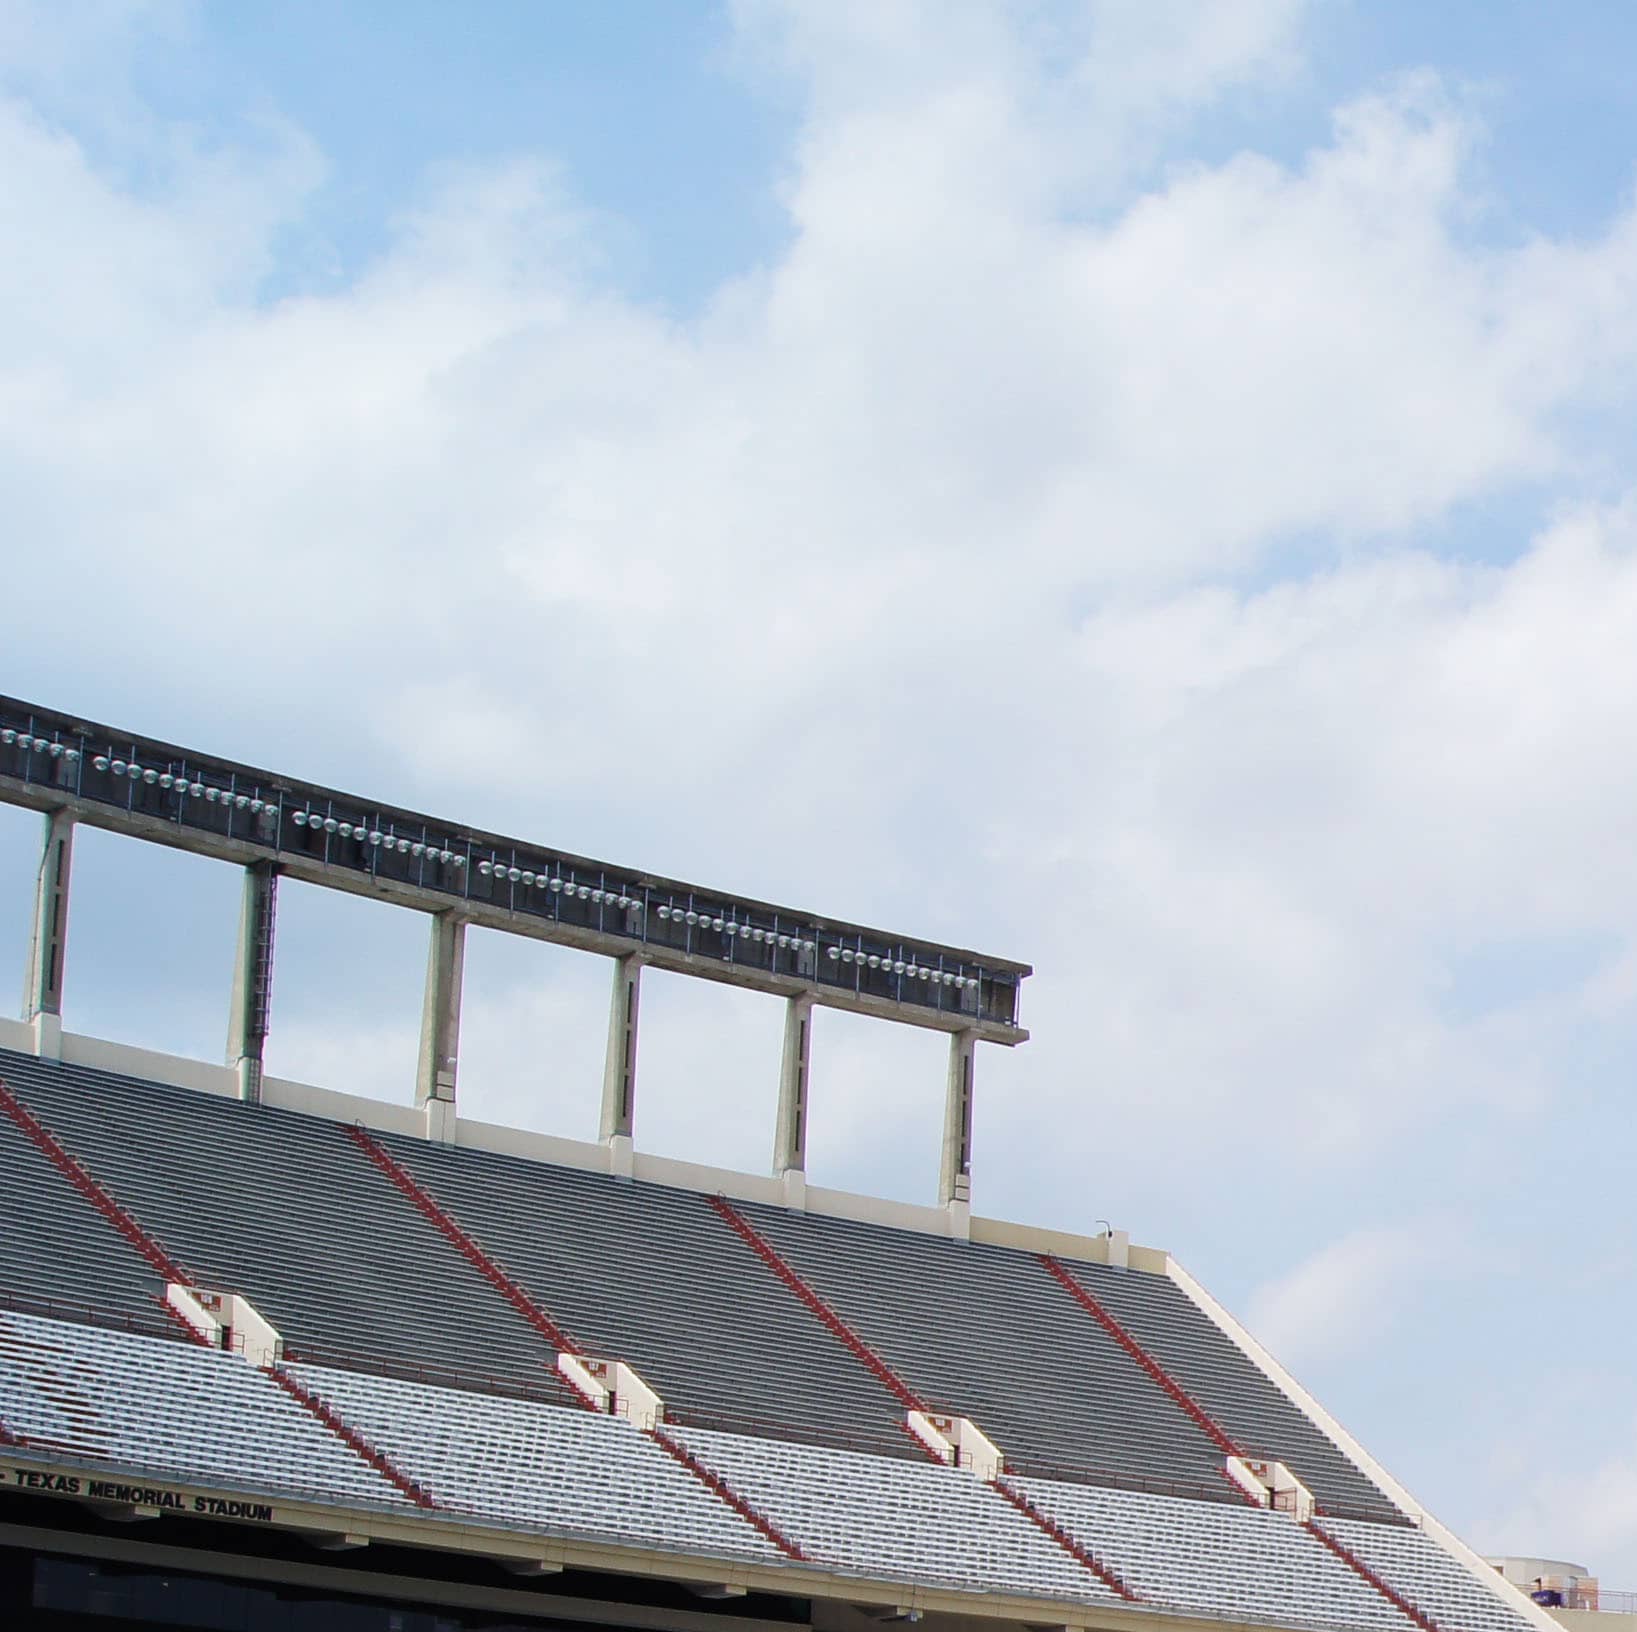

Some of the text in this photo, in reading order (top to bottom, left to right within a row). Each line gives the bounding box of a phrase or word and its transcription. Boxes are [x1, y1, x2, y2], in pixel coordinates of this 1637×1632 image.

[15, 1470, 272, 1521] TEXAS MEMORIAL STADIUM
